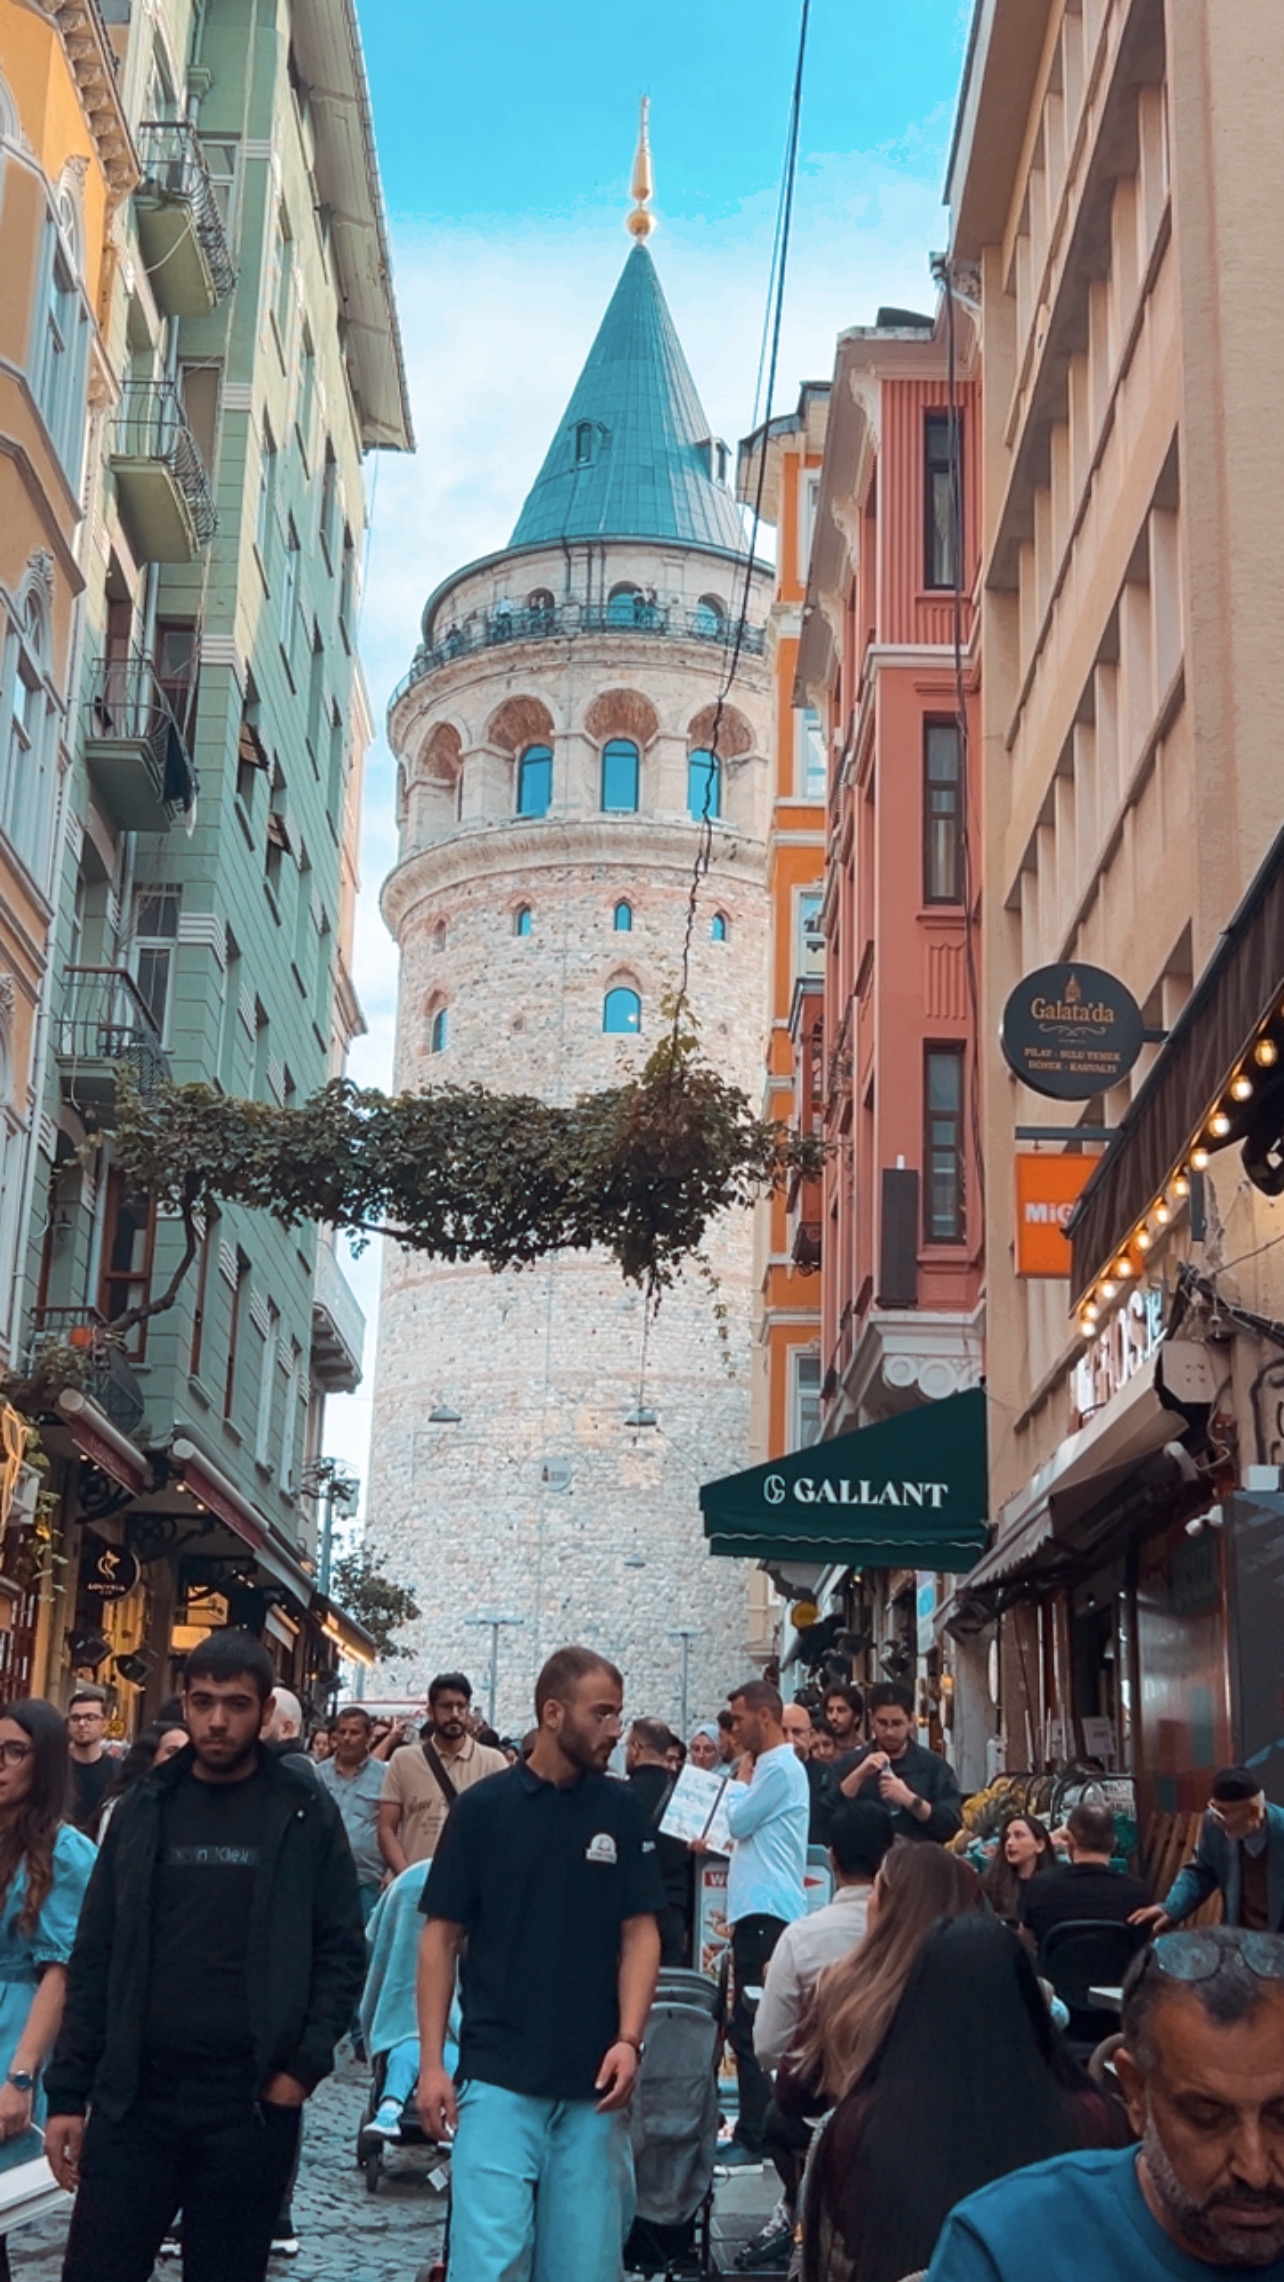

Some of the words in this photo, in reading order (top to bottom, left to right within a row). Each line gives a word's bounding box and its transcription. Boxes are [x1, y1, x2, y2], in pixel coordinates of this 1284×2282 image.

[1031, 998, 1115, 1023] Galata'da
[1025, 1202, 1075, 1228] MiG
[793, 1477, 949, 1508] GALLANT
